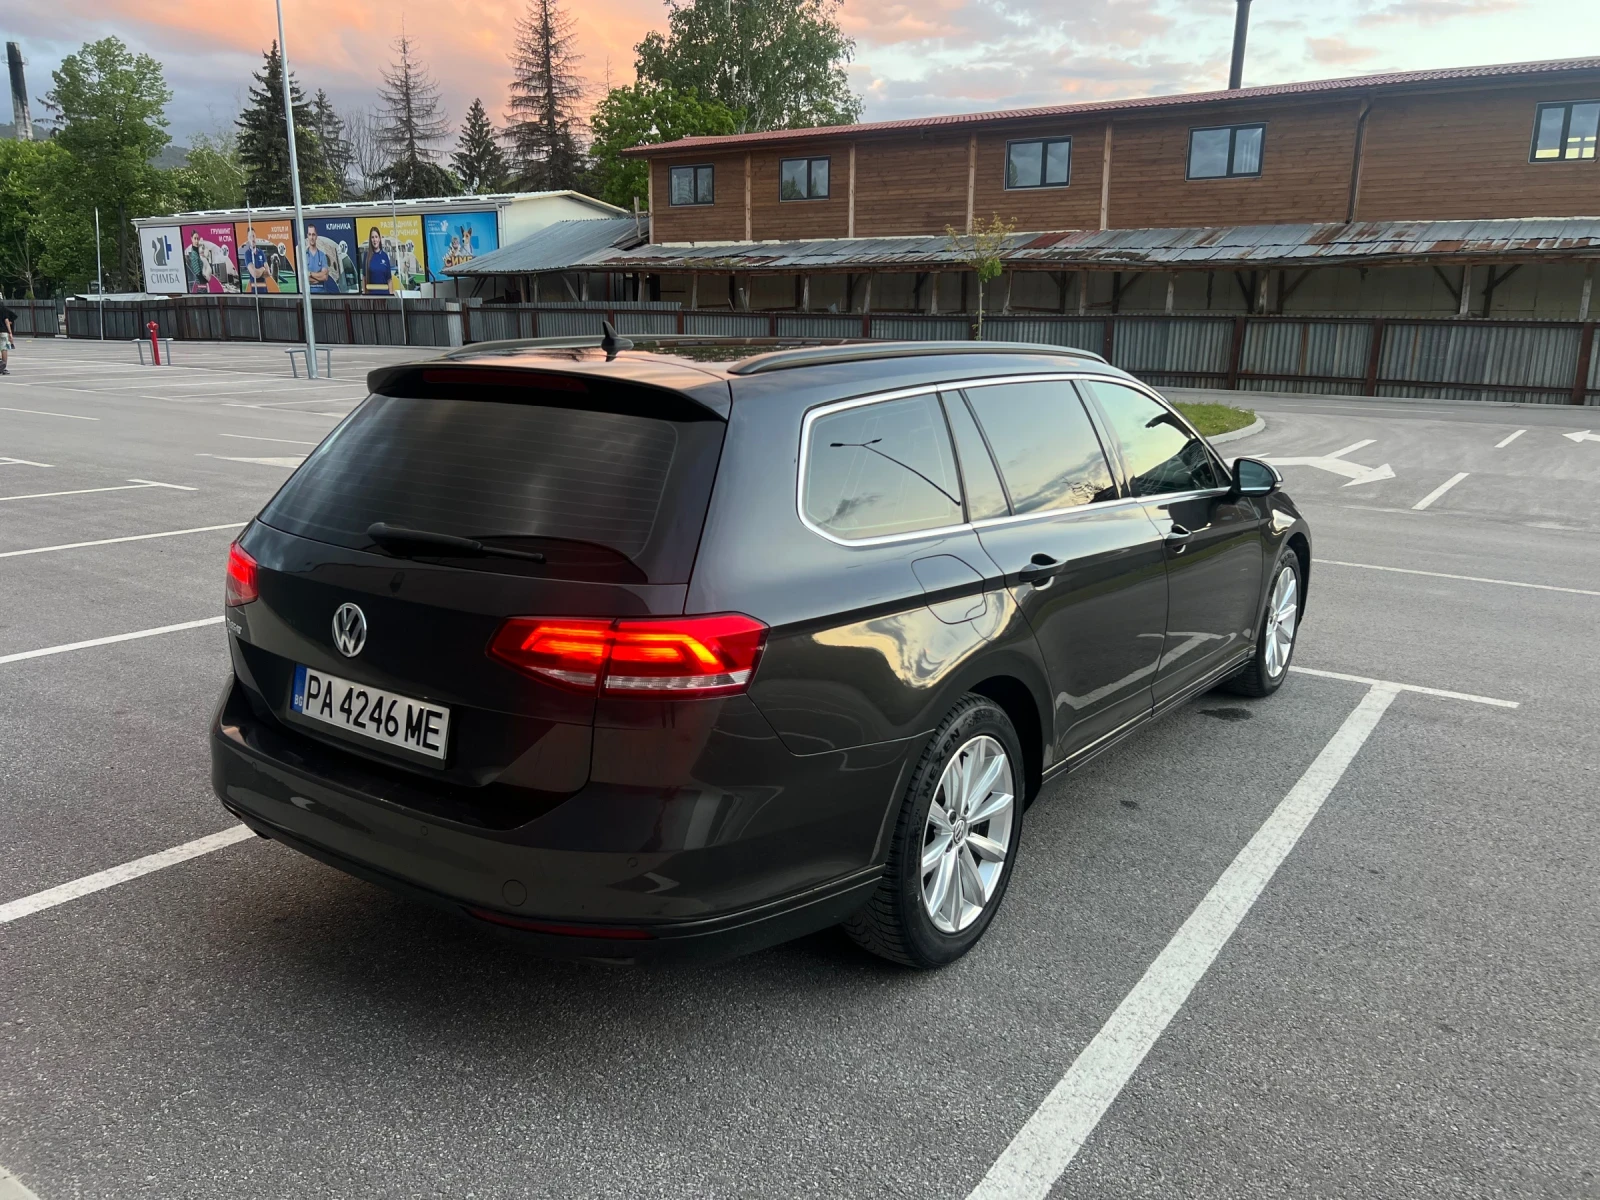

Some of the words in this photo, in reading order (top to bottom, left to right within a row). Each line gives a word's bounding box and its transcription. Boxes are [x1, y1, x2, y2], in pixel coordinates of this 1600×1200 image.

[325, 223, 351, 231] КЛИНИКА
[380, 220, 412, 229] РАЗВДНИК
[267, 233, 290, 241] УЧИЛИЩЕ
[150, 273, 181, 285] СИМБА
[294, 693, 303, 707] BG
[305, 674, 333, 719] PA
[339, 687, 399, 738] 4246
[404, 704, 443, 752] ME
[922, 727, 961, 799] NEXEN
